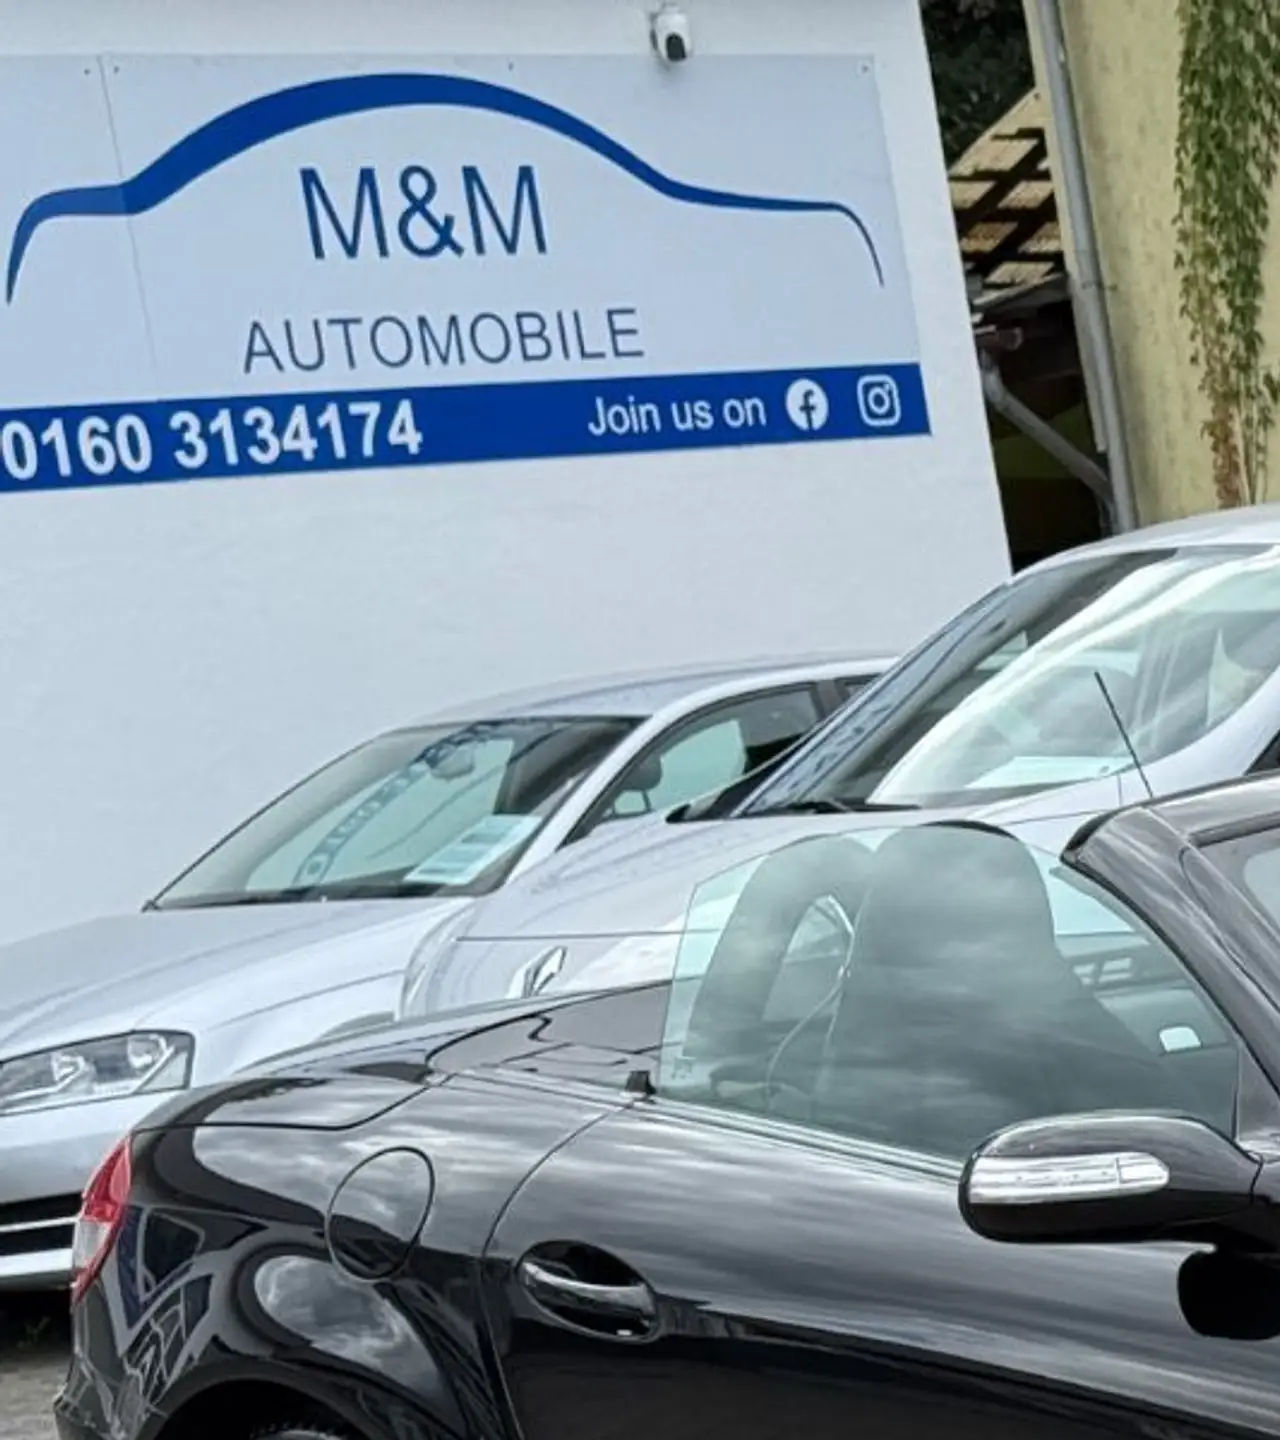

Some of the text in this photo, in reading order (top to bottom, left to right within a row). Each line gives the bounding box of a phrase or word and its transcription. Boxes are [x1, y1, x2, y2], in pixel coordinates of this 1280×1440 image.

[299, 164, 548, 261] M&M
[243, 307, 645, 375] AUTOMOBILE
[1, 399, 423, 481] 0160 3134174
[588, 396, 767, 436] Join us on
